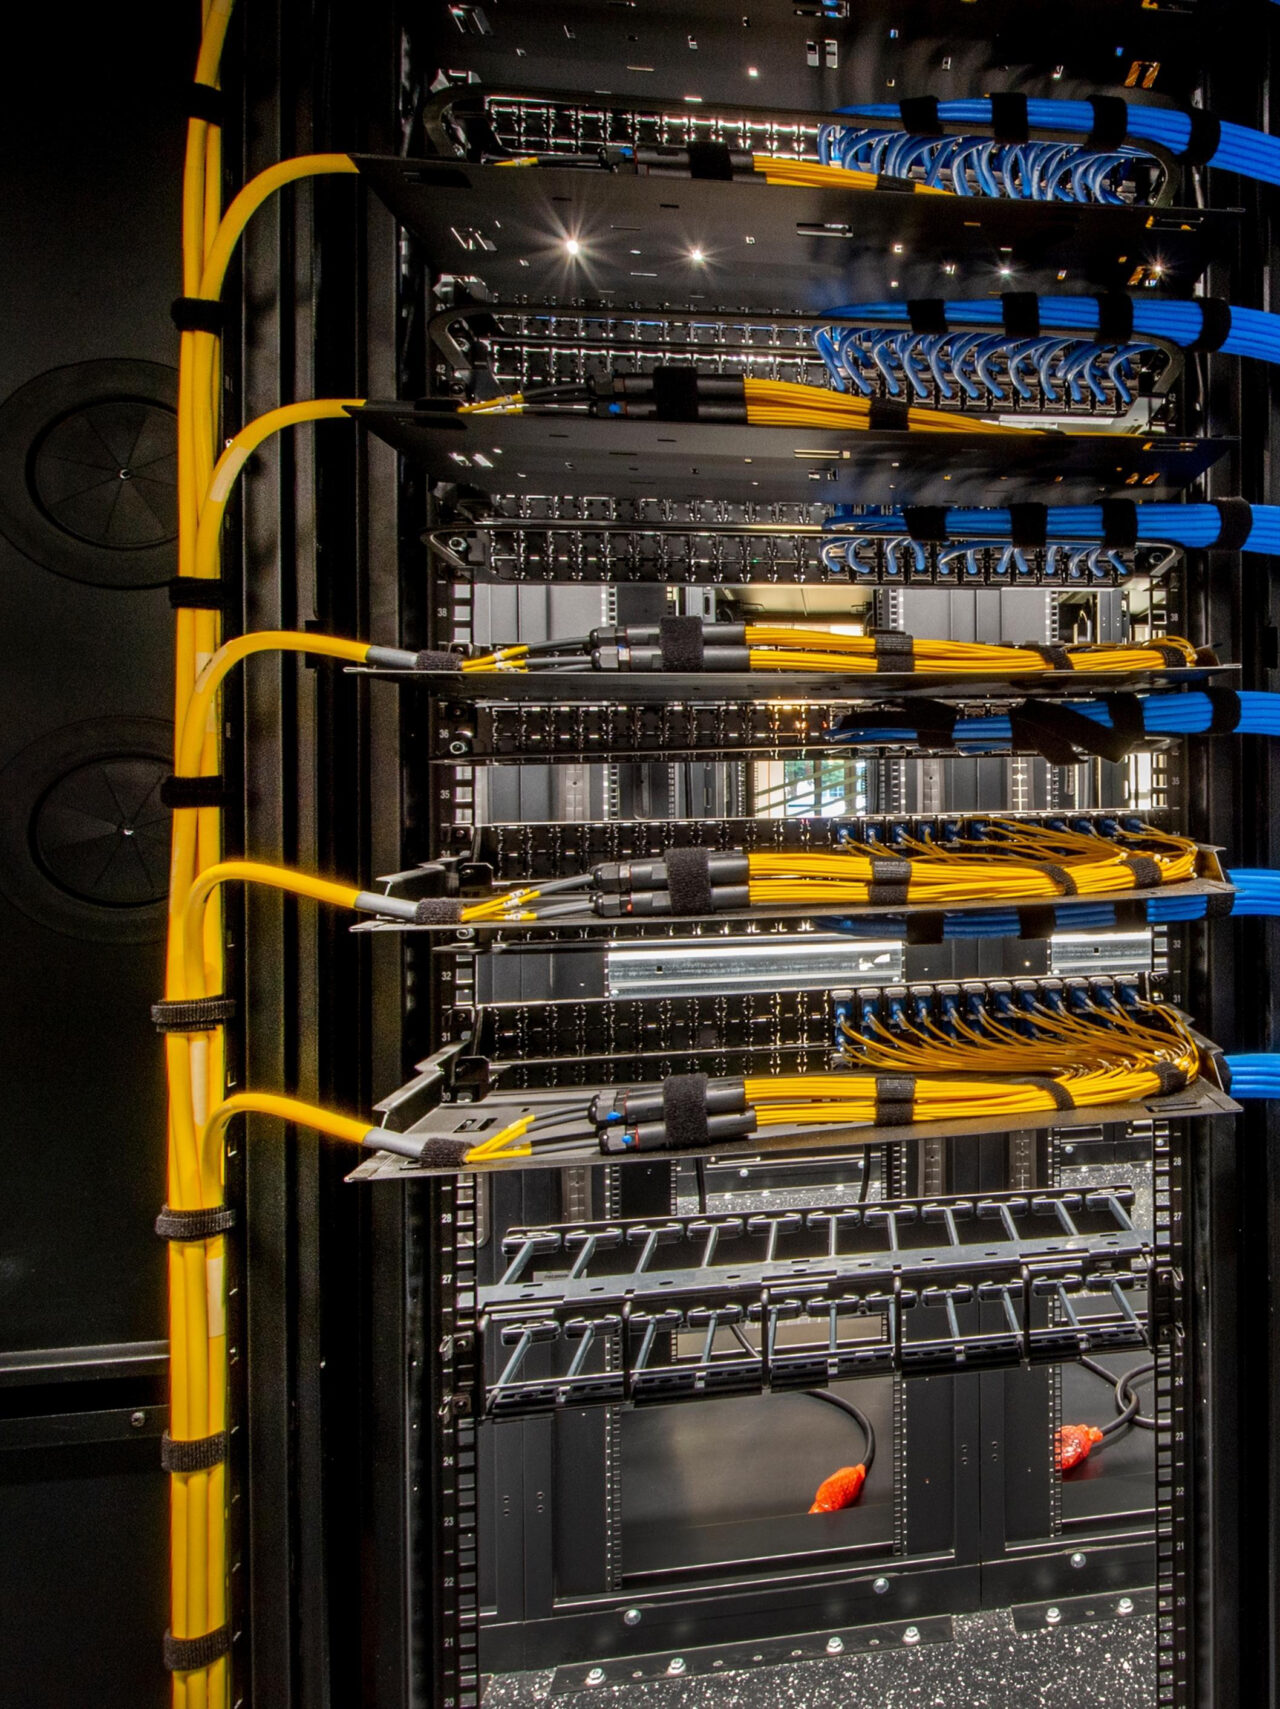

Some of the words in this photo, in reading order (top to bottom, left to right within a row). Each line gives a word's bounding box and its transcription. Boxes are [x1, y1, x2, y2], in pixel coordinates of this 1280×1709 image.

[436, 365, 445, 373] 42
[438, 608, 447, 617] 38
[439, 729, 449, 738] 36
[440, 790, 450, 799] 35
[1173, 940, 1181, 948] 32
[442, 971, 451, 980] 32
[1173, 994, 1180, 1003] 31
[442, 1032, 450, 1041] 31
[441, 1092, 451, 1101] 30
[1173, 1157, 1181, 1165] 28
[442, 1213, 452, 1223] 28
[1174, 1212, 1181, 1220] 27
[442, 1274, 452, 1284] 27
[1175, 1376, 1183, 1386] 24
[1176, 1432, 1183, 1441] 23
[443, 1457, 453, 1466] 24
[1176, 1487, 1184, 1495] 22
[444, 1517, 454, 1526] 23
[1177, 1542, 1184, 1550] 21
[444, 1577, 454, 1587] 22
[1177, 1597, 1185, 1606] 20
[445, 1638, 453, 1647] 21
[1178, 1651, 1185, 1659] 19
[444, 1698, 454, 1707] 20
